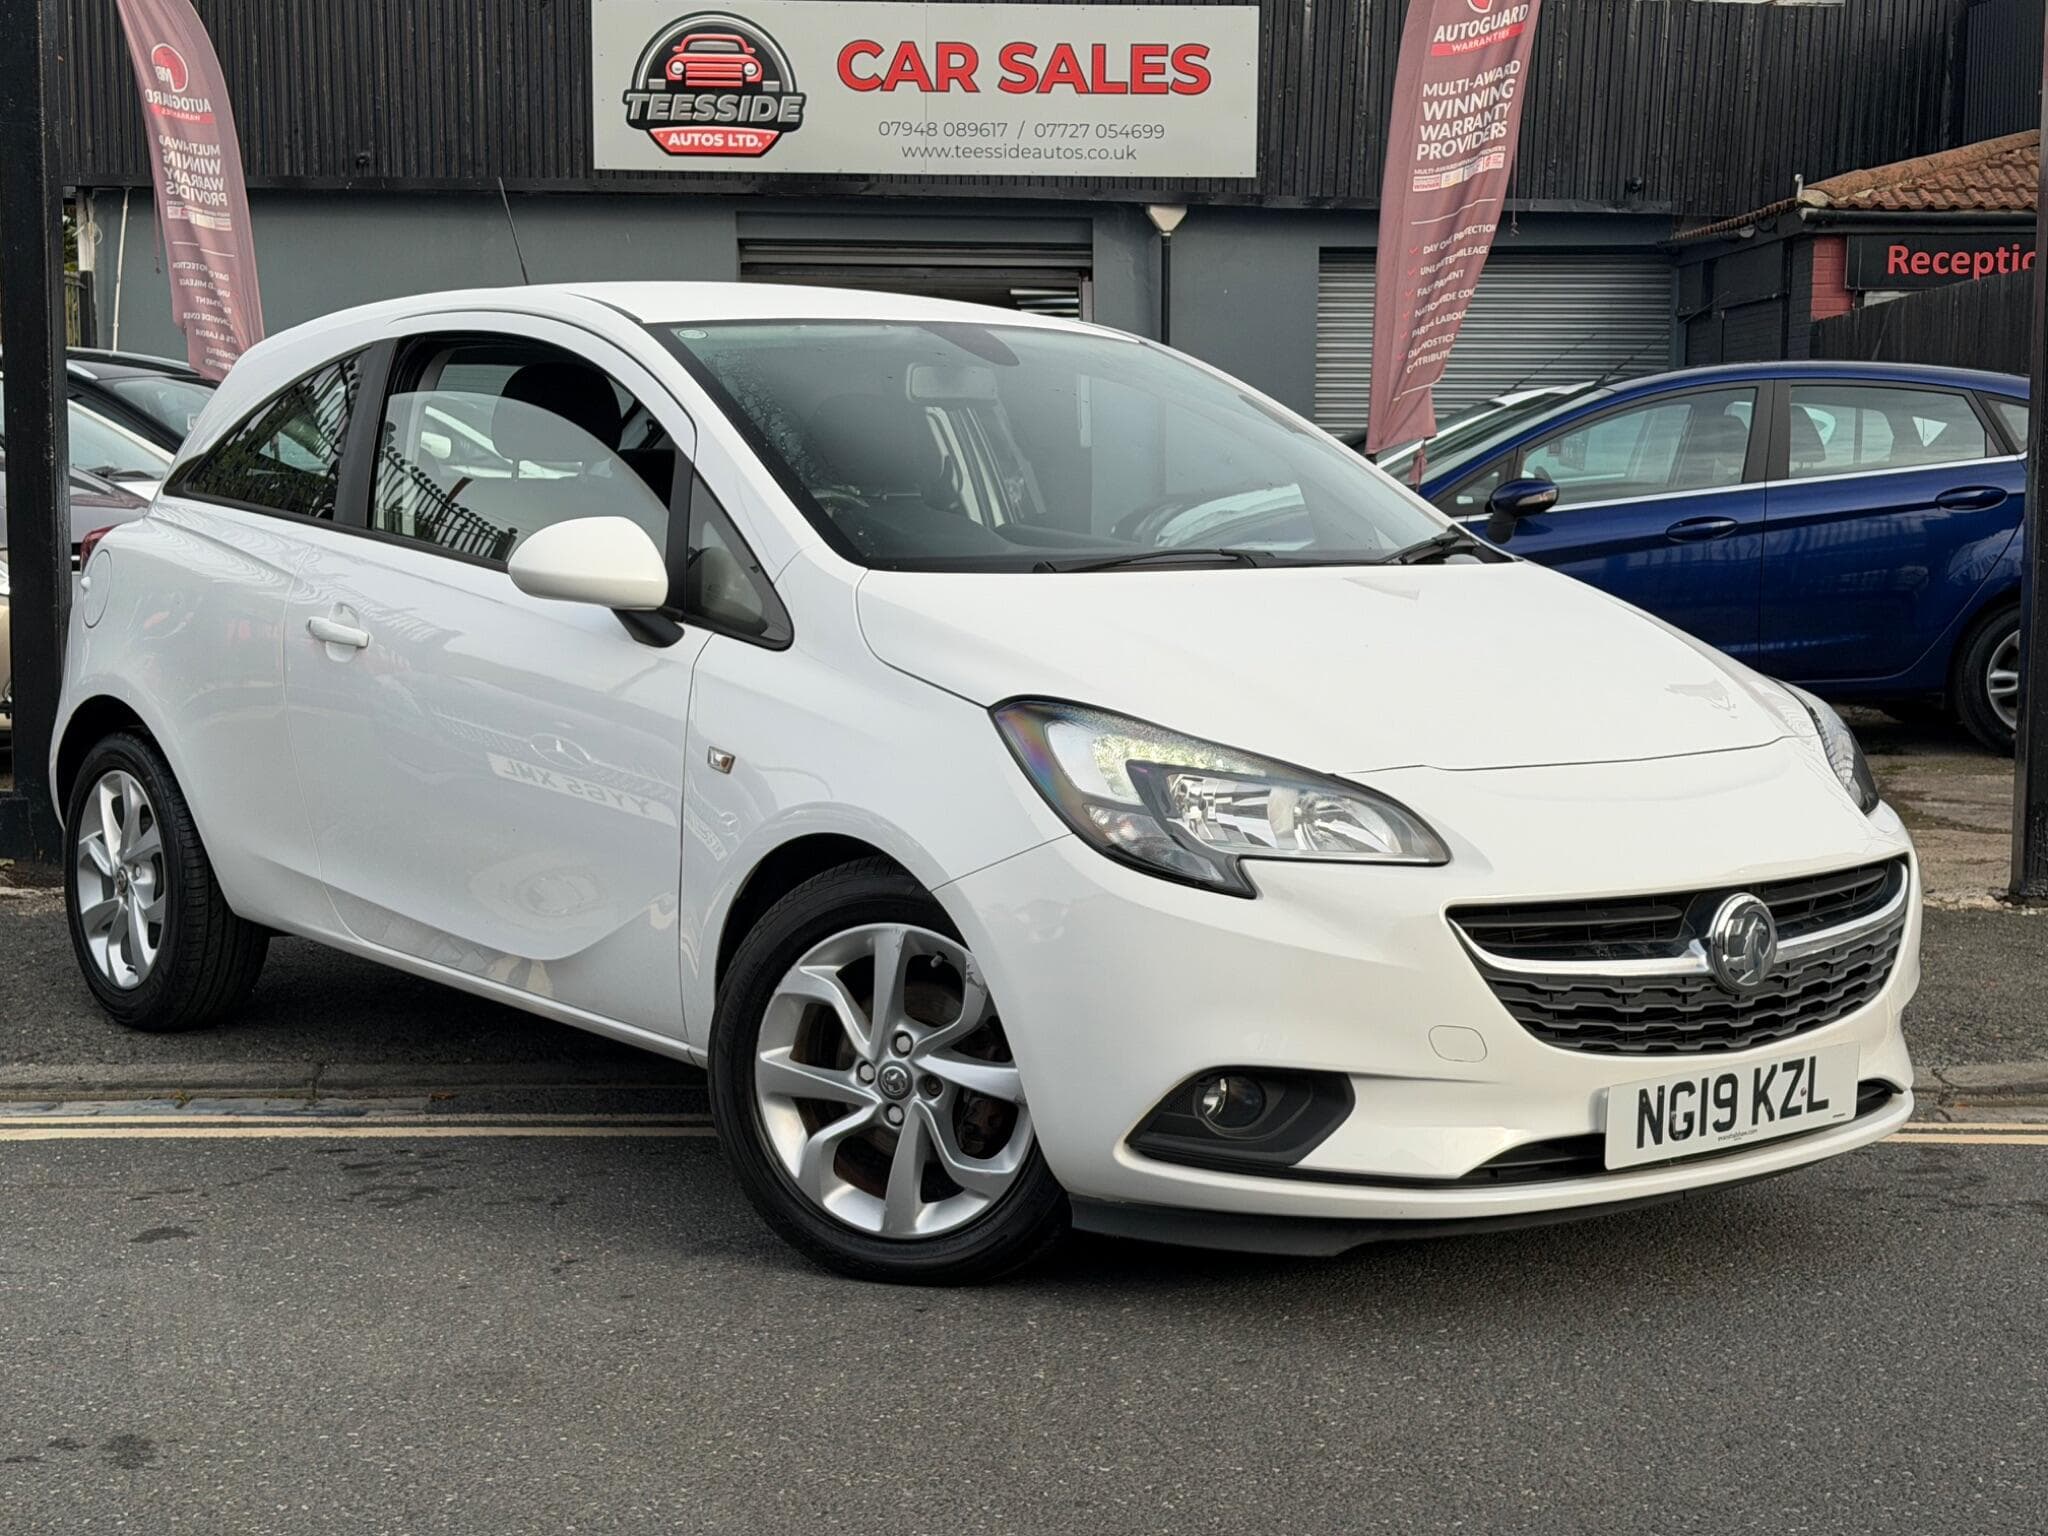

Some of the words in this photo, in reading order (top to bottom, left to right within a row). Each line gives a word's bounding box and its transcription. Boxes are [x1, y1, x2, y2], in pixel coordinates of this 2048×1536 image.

[1433, 4, 1529, 43] AUTOGUARD
[837, 39, 980, 93] CAR
[998, 42, 1212, 95] SALES
[1423, 60, 1521, 98] MULTI-AWARD
[626, 93, 803, 123] TEESSIDE
[1423, 79, 1515, 121] WINNING
[668, 133, 724, 147] AUTOS
[727, 134, 763, 148] LTD.
[878, 121, 938, 137] 07948
[943, 122, 1008, 138] 089617
[1033, 123, 1090, 139] 07727
[1095, 124, 1165, 140] 054699
[1416, 121, 1508, 161] PROVIDERS
[1420, 102, 1512, 142] WARRANTY
[901, 144, 1137, 161] www.teessideautos.co.uk
[1637, 1073, 1738, 1149] NG19
[1751, 1056, 1829, 1126] KZL
